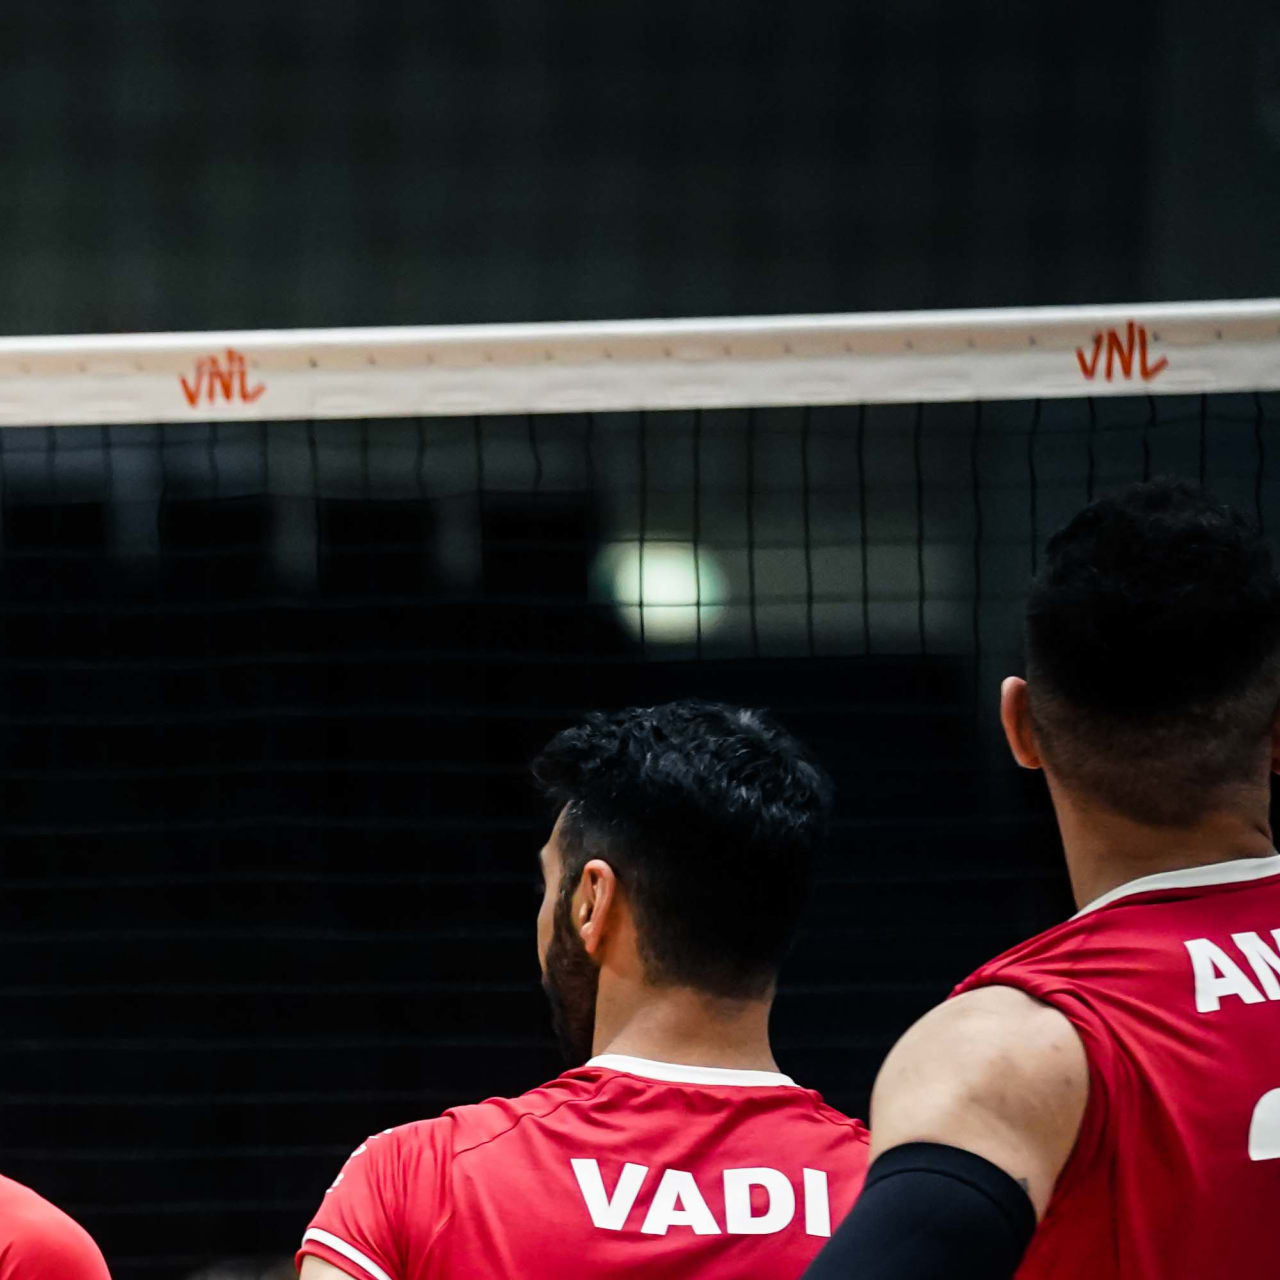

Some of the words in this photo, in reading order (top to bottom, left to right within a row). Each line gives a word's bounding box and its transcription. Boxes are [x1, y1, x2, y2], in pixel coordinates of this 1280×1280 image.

[179, 348, 266, 407] VNL
[1075, 320, 1168, 381] VNL
[571, 1158, 831, 1237] VADI
